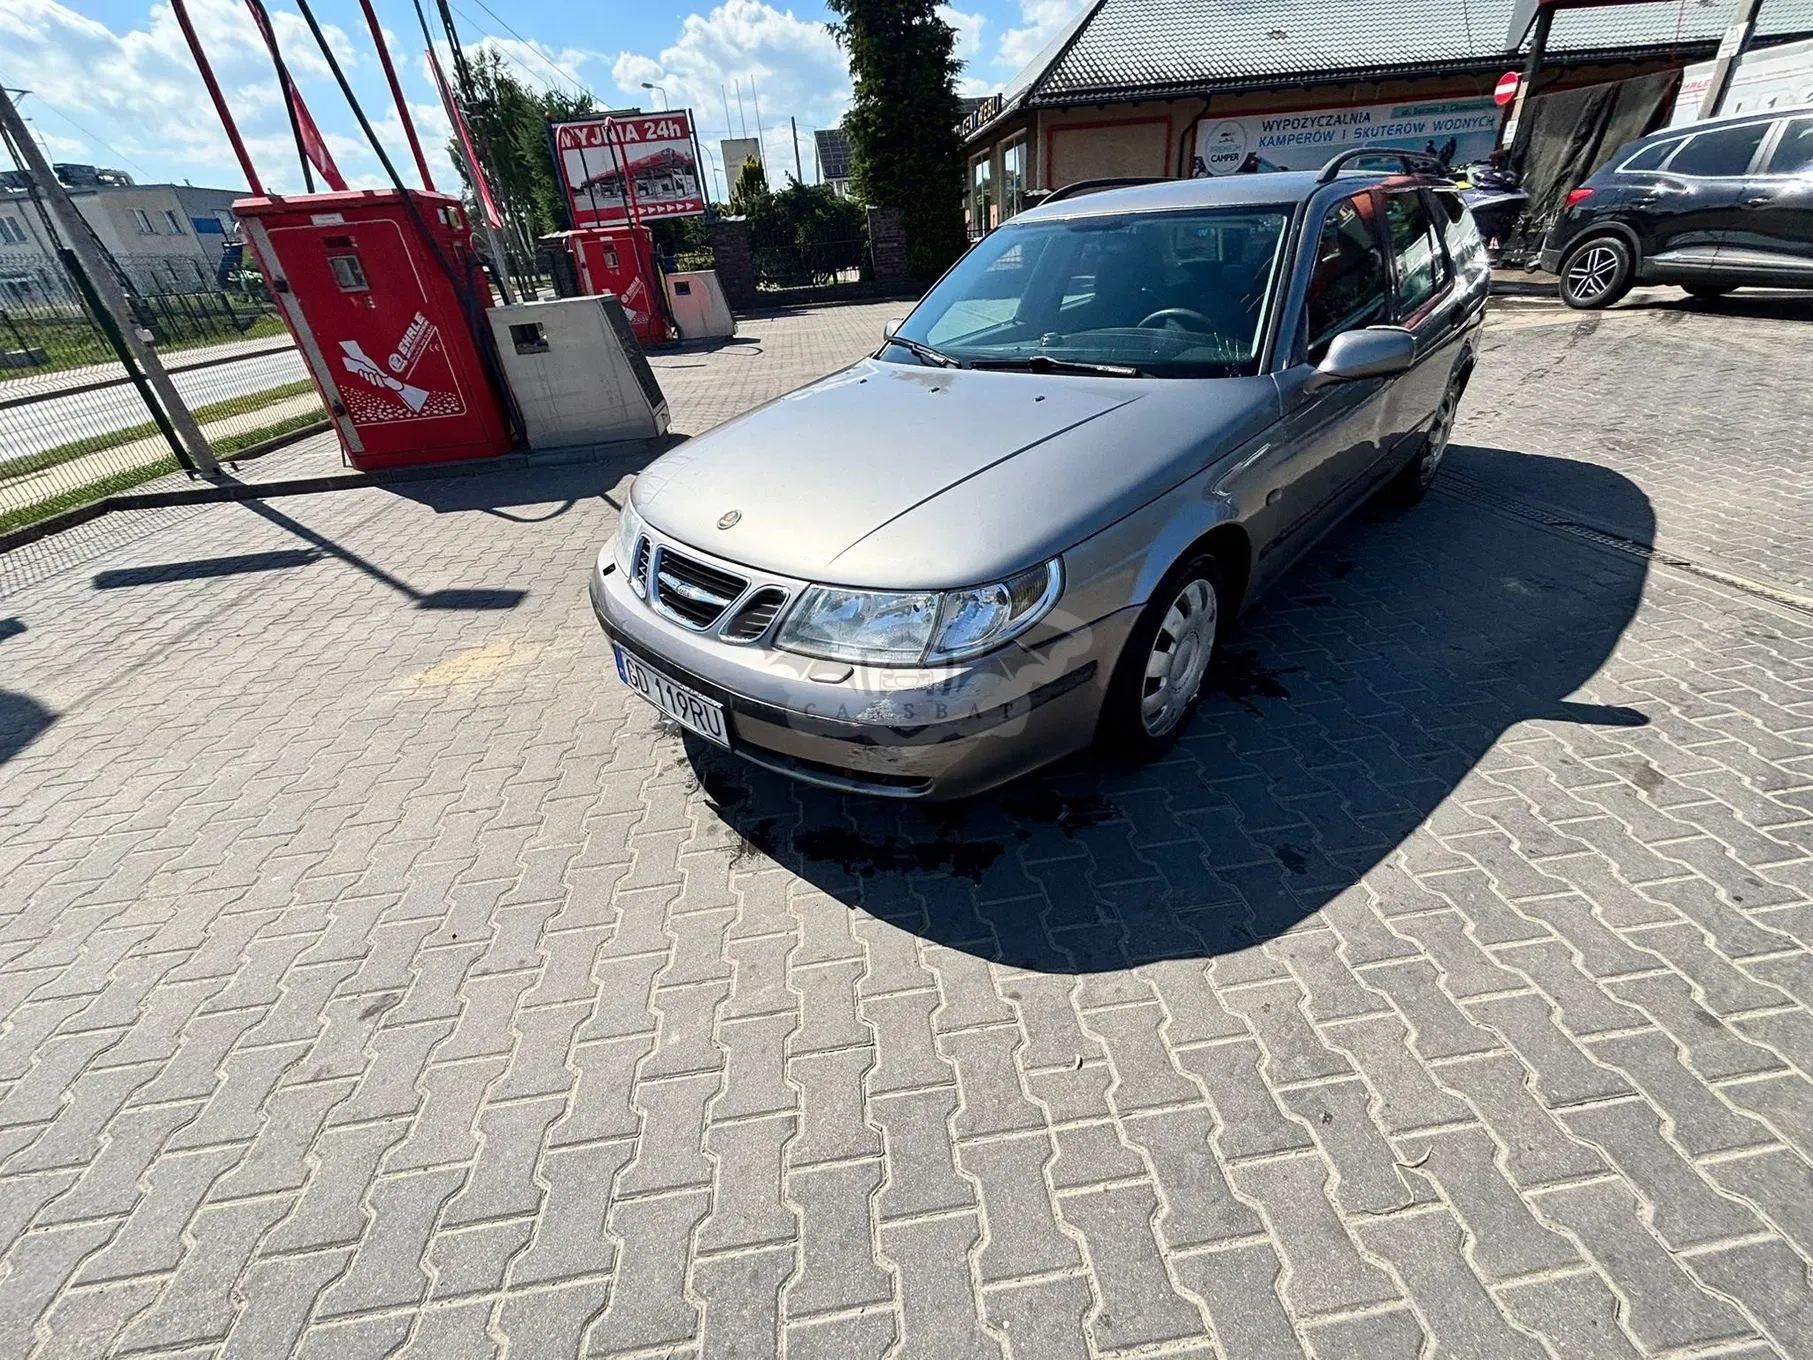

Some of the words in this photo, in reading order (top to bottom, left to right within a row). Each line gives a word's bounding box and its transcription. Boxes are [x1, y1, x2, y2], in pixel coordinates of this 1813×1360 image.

[644, 120, 681, 140] 24h
[1259, 129, 1335, 148] KAMPERÓW
[1354, 121, 1426, 139] SKUTERÓW
[1433, 115, 1496, 131] WODNYCH
[1210, 152, 1239, 163] CAMPER
[626, 658, 649, 694] GD
[655, 677, 721, 737] 119RU
